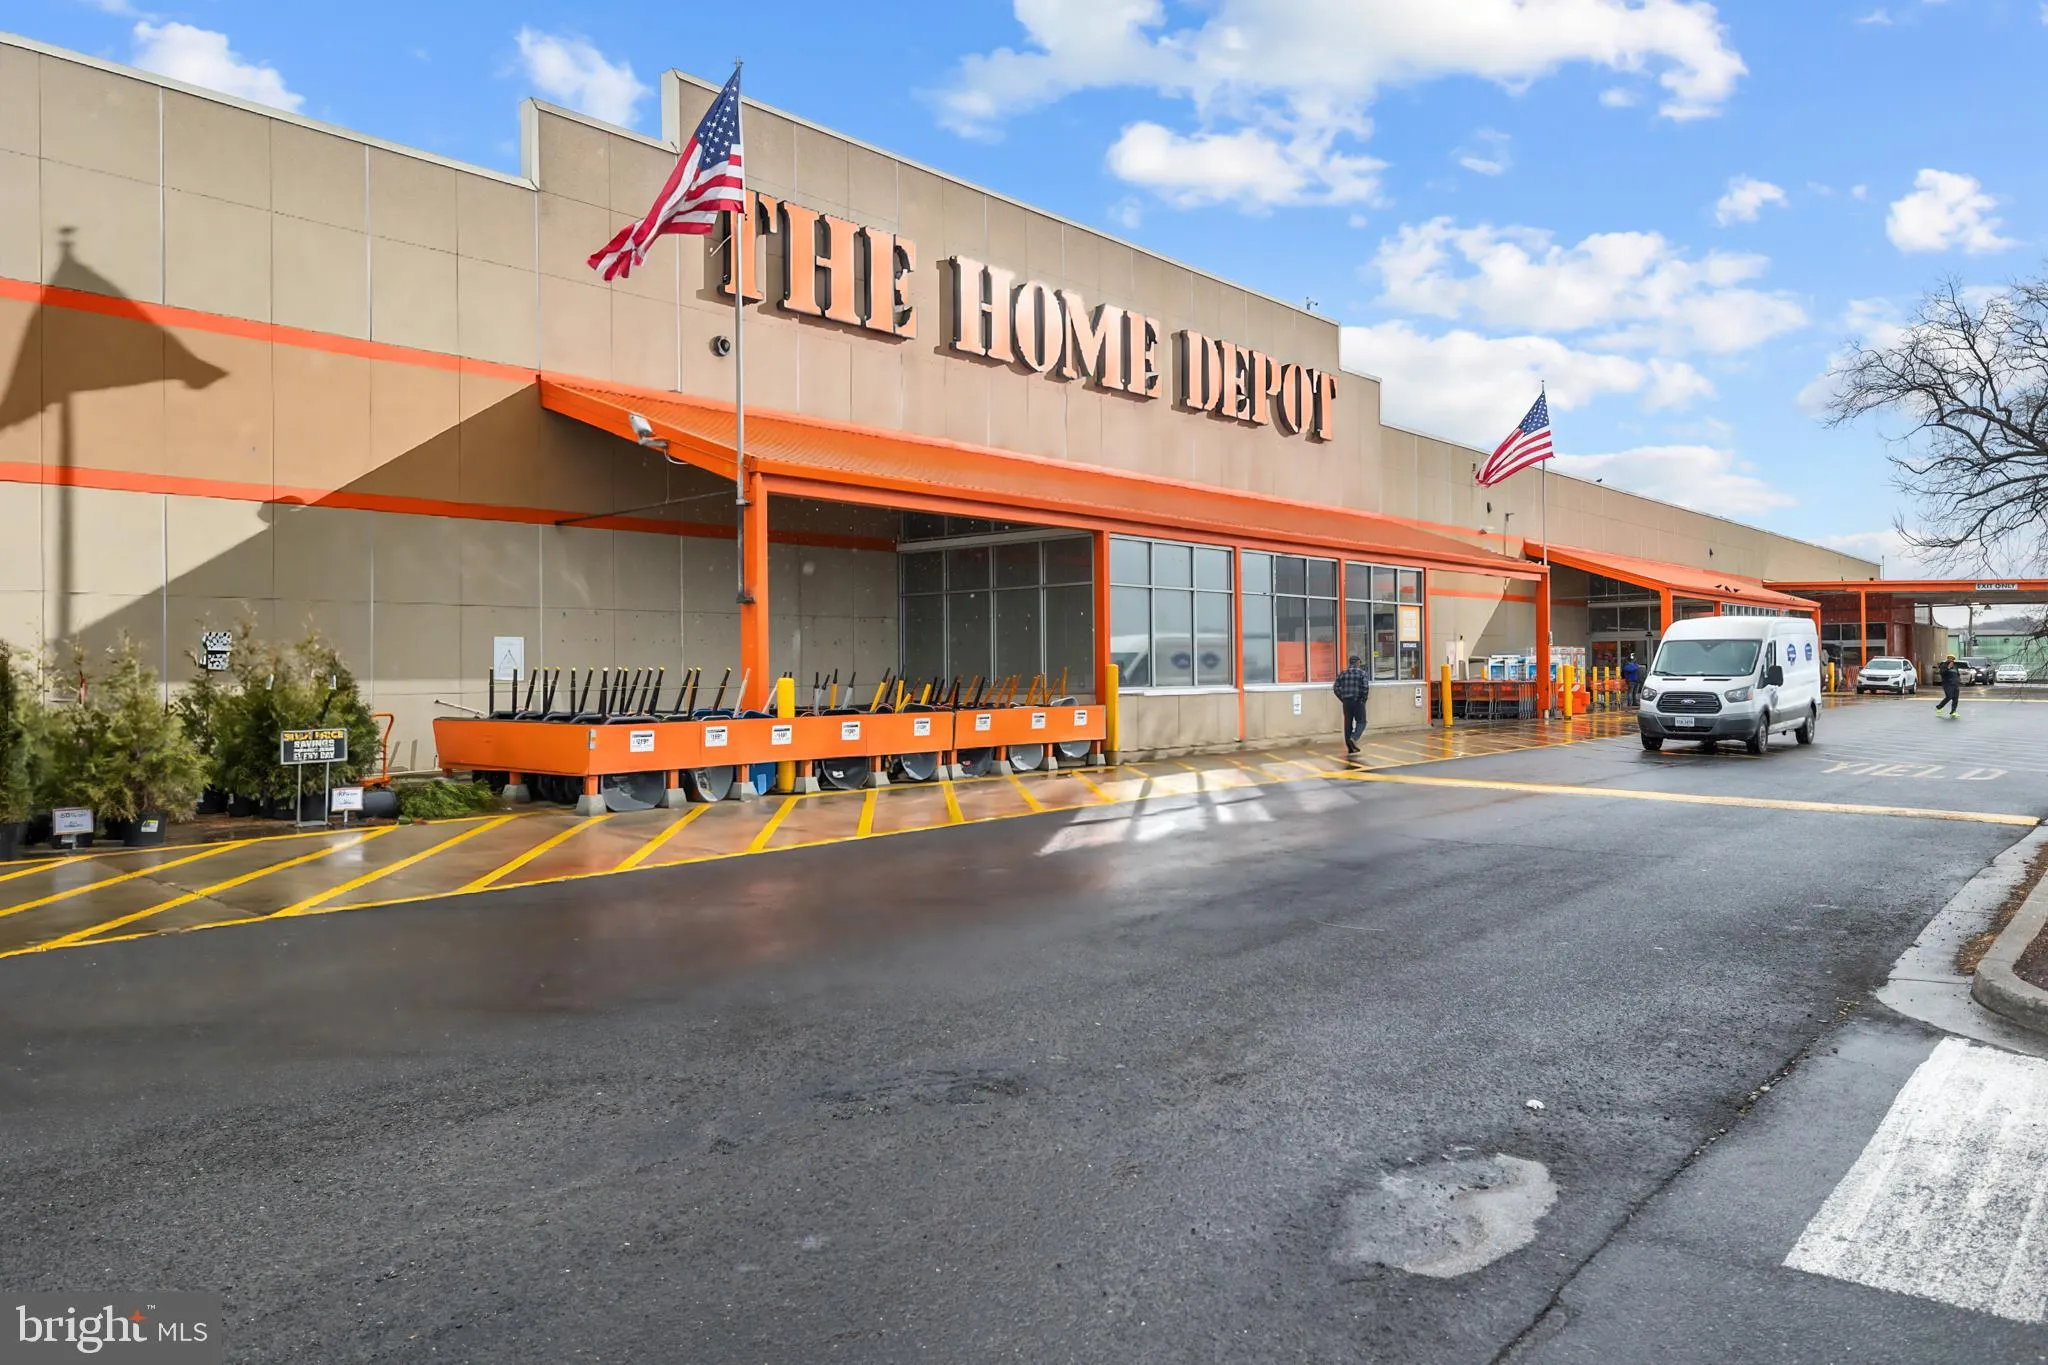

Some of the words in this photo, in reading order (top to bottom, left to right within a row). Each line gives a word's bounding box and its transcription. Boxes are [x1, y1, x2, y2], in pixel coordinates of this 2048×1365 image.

[724, 190, 918, 340] THE
[952, 254, 1161, 400] HOME
[1182, 329, 1339, 442] DEPOT
[314, 731, 344, 740] PRICE
[294, 740, 335, 749] SAVINGS
